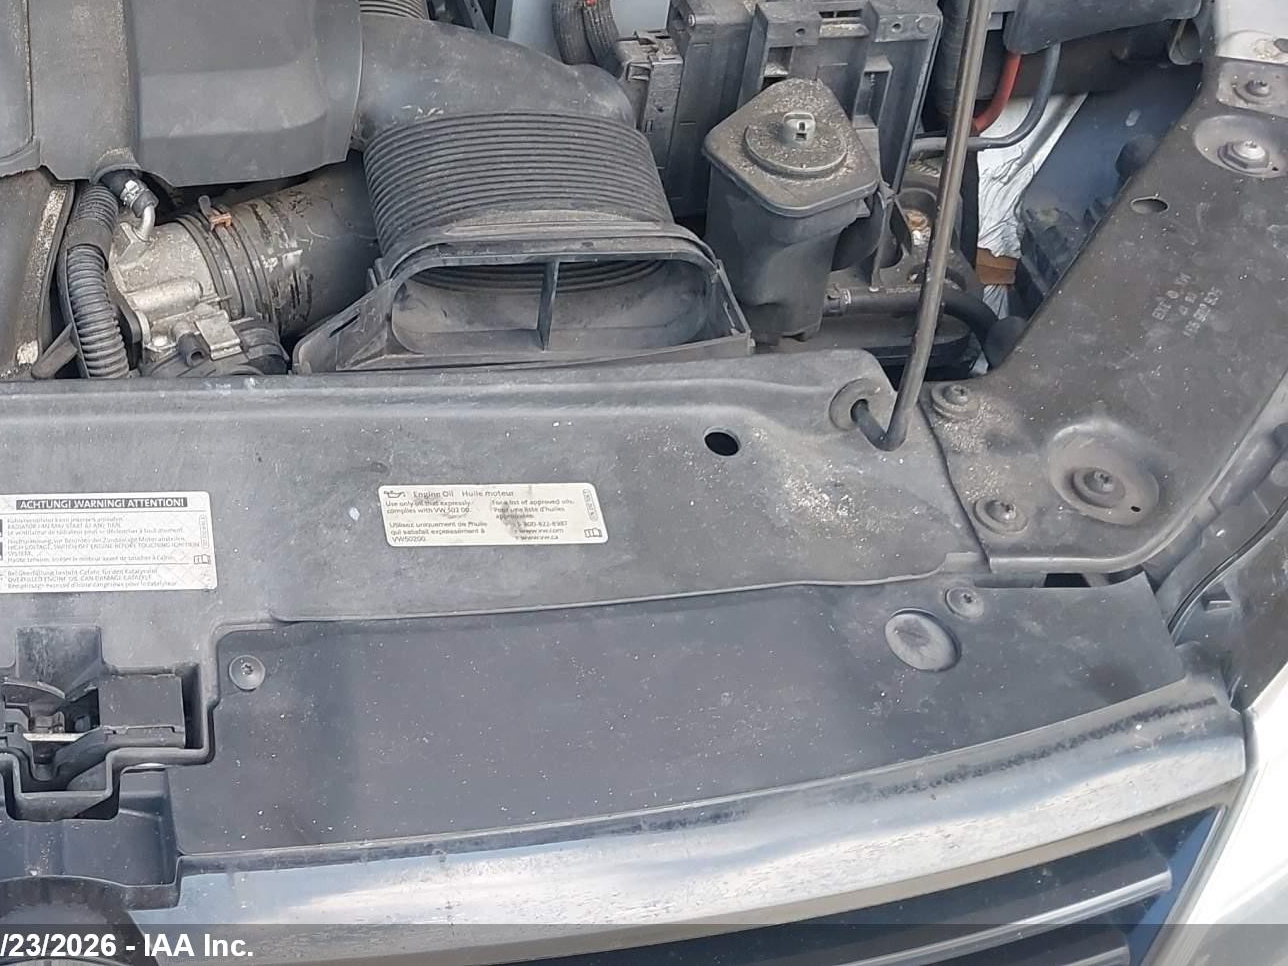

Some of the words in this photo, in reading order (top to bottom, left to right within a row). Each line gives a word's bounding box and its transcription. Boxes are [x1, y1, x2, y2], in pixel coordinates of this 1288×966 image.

[20, 499, 71, 509] ACHTUNG!
[74, 499, 125, 508] WARNING!
[127, 498, 184, 507] ATTENTION!
